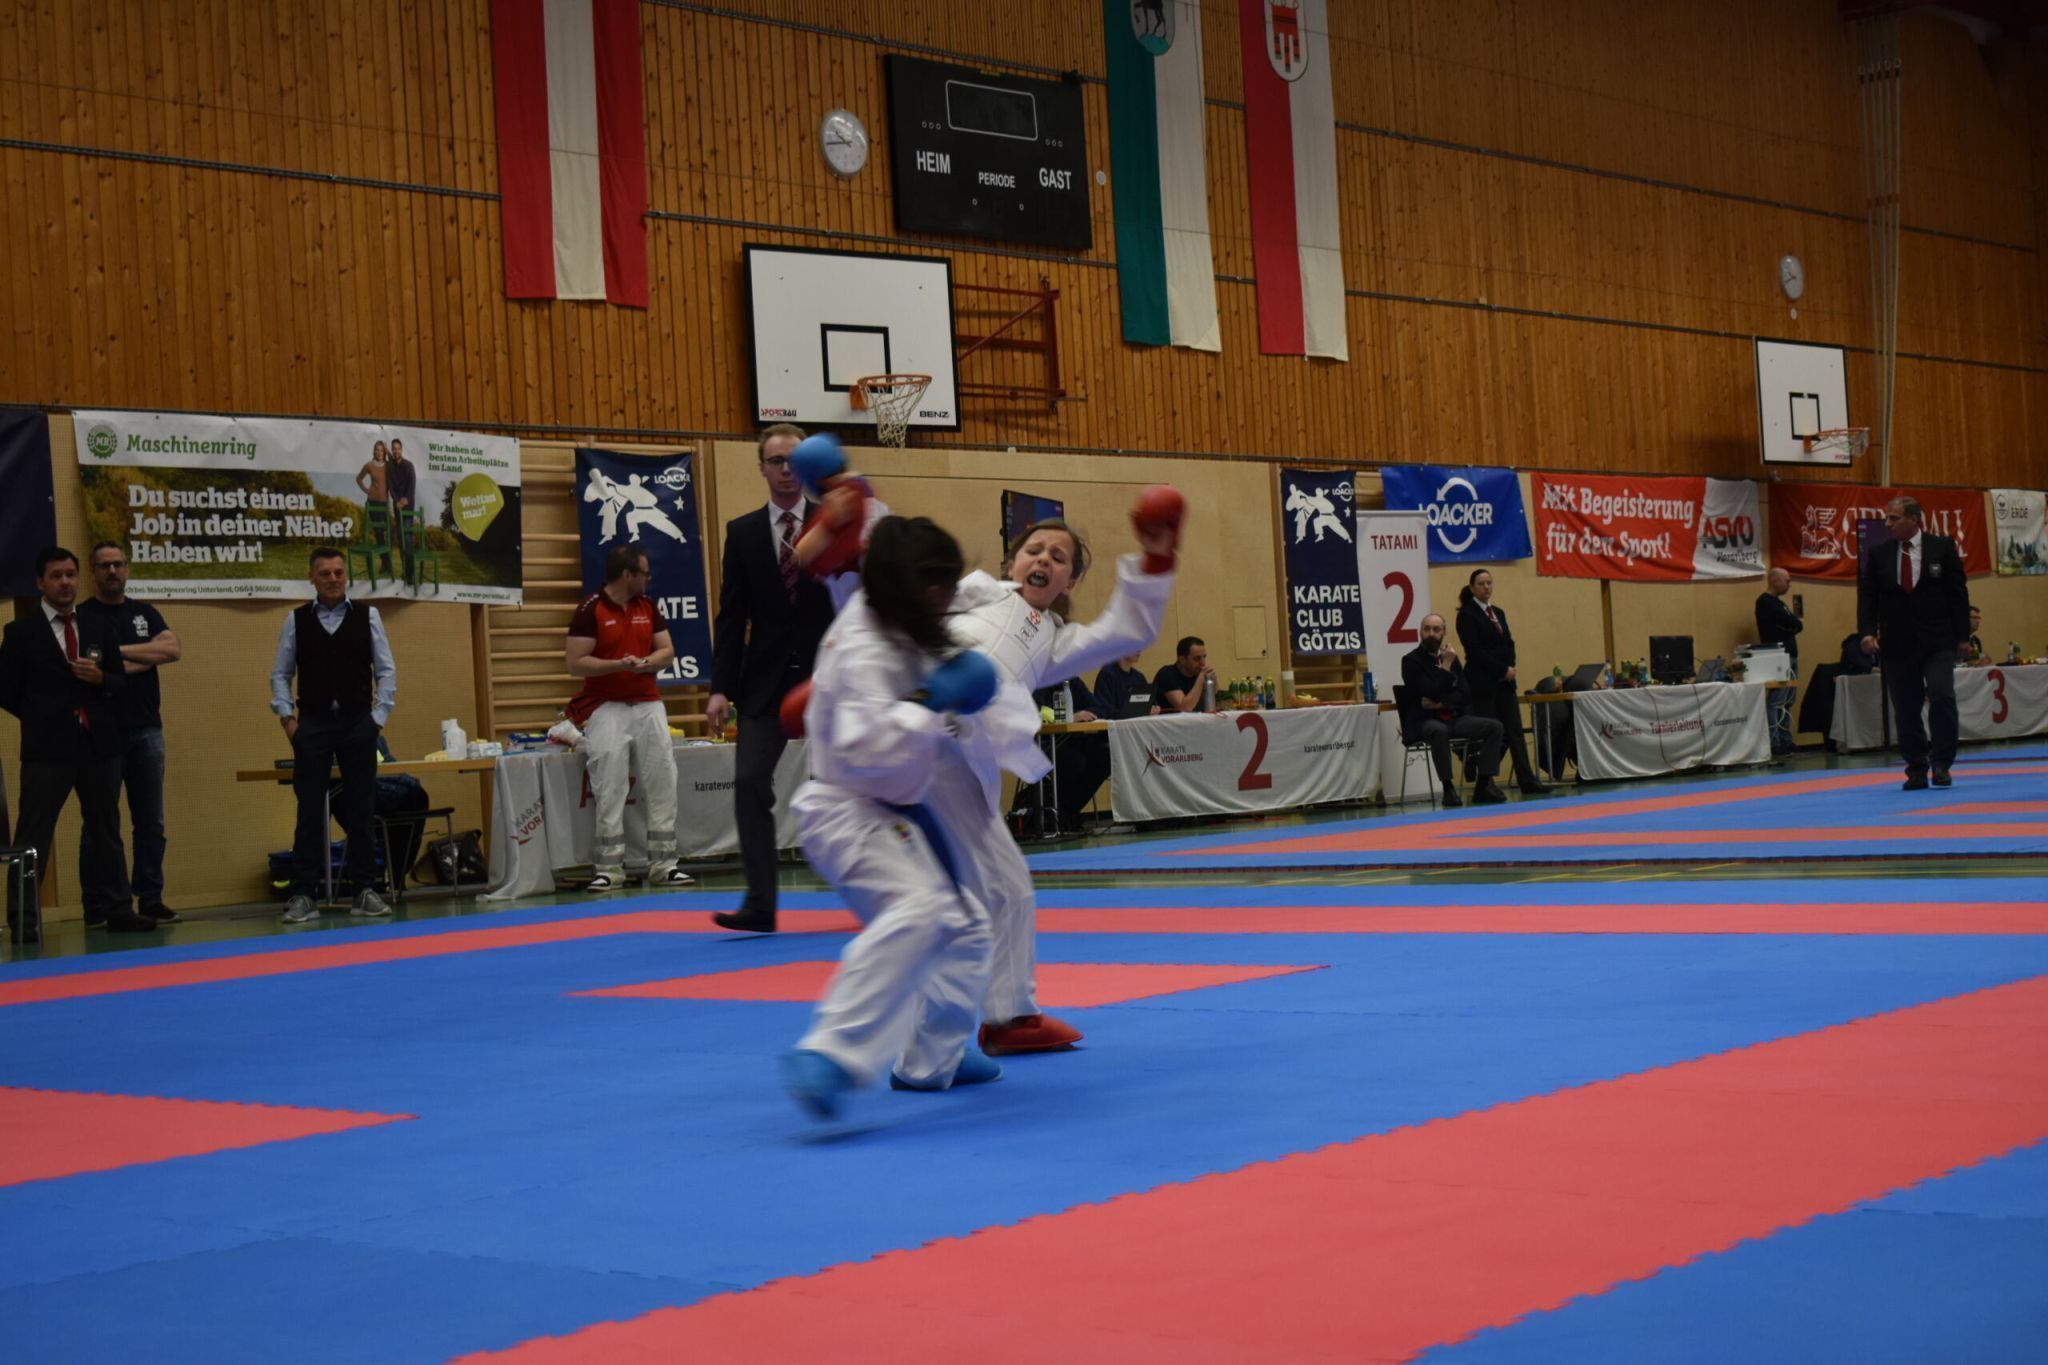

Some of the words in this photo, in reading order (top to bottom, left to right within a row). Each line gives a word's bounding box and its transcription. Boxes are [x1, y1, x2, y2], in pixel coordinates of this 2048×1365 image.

[916, 150, 950, 174] HEIM
[978, 171, 1016, 188] PERIODE
[1039, 167, 1072, 190] GAST
[126, 434, 257, 460] Maschinenring
[429, 443, 443, 451] Wir
[445, 445, 470, 454] haben
[429, 454, 457, 462] besten
[459, 456, 509, 467] Arbeitsplätze
[429, 463, 440, 471] im
[441, 464, 462, 472] Land
[128, 485, 165, 507] Du
[169, 487, 248, 509] suchst
[250, 487, 315, 510] einen
[1541, 482, 1577, 513] Mit
[1579, 487, 1695, 529] Begeisterung
[130, 512, 175, 535] Job
[177, 512, 201, 535] in
[204, 514, 282, 537] deiner
[285, 515, 354, 538] Nähe?
[131, 540, 212, 563] Haben
[214, 540, 264, 563] wir!
[1371, 535, 1418, 550] TATAMI
[1546, 522, 1577, 561] für
[1579, 526, 1615, 557] den
[1618, 531, 1672, 566] Sport!
[1294, 585, 1361, 604] KARATE
[657, 596, 699, 620] ATE
[1297, 608, 1343, 627] CLUB
[1383, 571, 1419, 644] 2
[1299, 629, 1361, 651] GÖTZIS
[656, 655, 700, 680] ZIS
[1987, 669, 2008, 724] 3
[1161, 752, 1203, 763] VORARLBERG
[1236, 712, 1272, 791] 2
